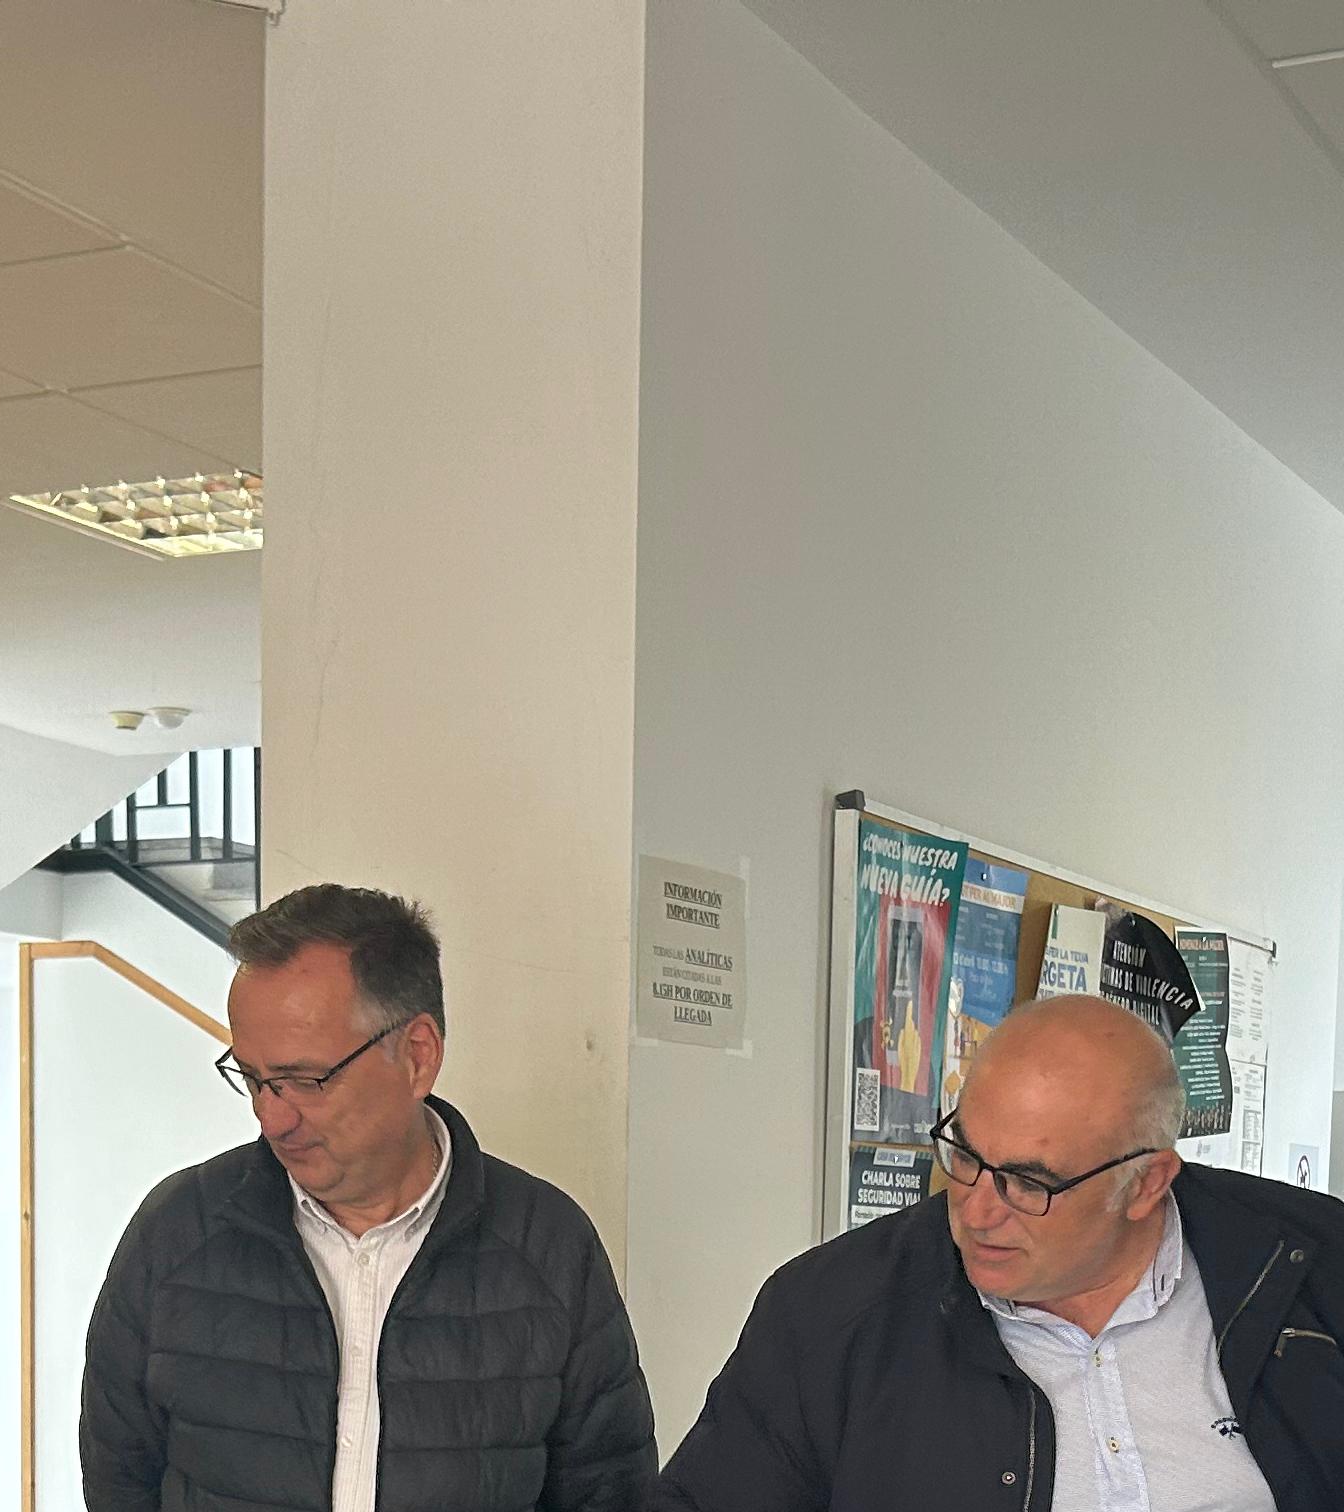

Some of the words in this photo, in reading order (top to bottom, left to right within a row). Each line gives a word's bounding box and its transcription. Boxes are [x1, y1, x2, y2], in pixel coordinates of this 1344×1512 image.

[902, 844, 958, 871] NUESTRA
[664, 881, 722, 907] INFORMACIÓN
[861, 864, 899, 898] NUEVA
[900, 868, 950, 907] GUÍA?
[666, 903, 720, 928] IMPORTANTE
[685, 947, 733, 970] ANALÍTICAS
[1124, 970, 1133, 993] DE
[674, 985, 692, 1001] POR
[693, 989, 719, 1006] ORDEN
[722, 993, 733, 1007] DE
[674, 1006, 712, 1025] LLEGADA
[862, 1170, 893, 1187] CHARLA
[895, 1173, 921, 1189] SOBRE
[858, 1188, 903, 1206] SEGURIDAD
